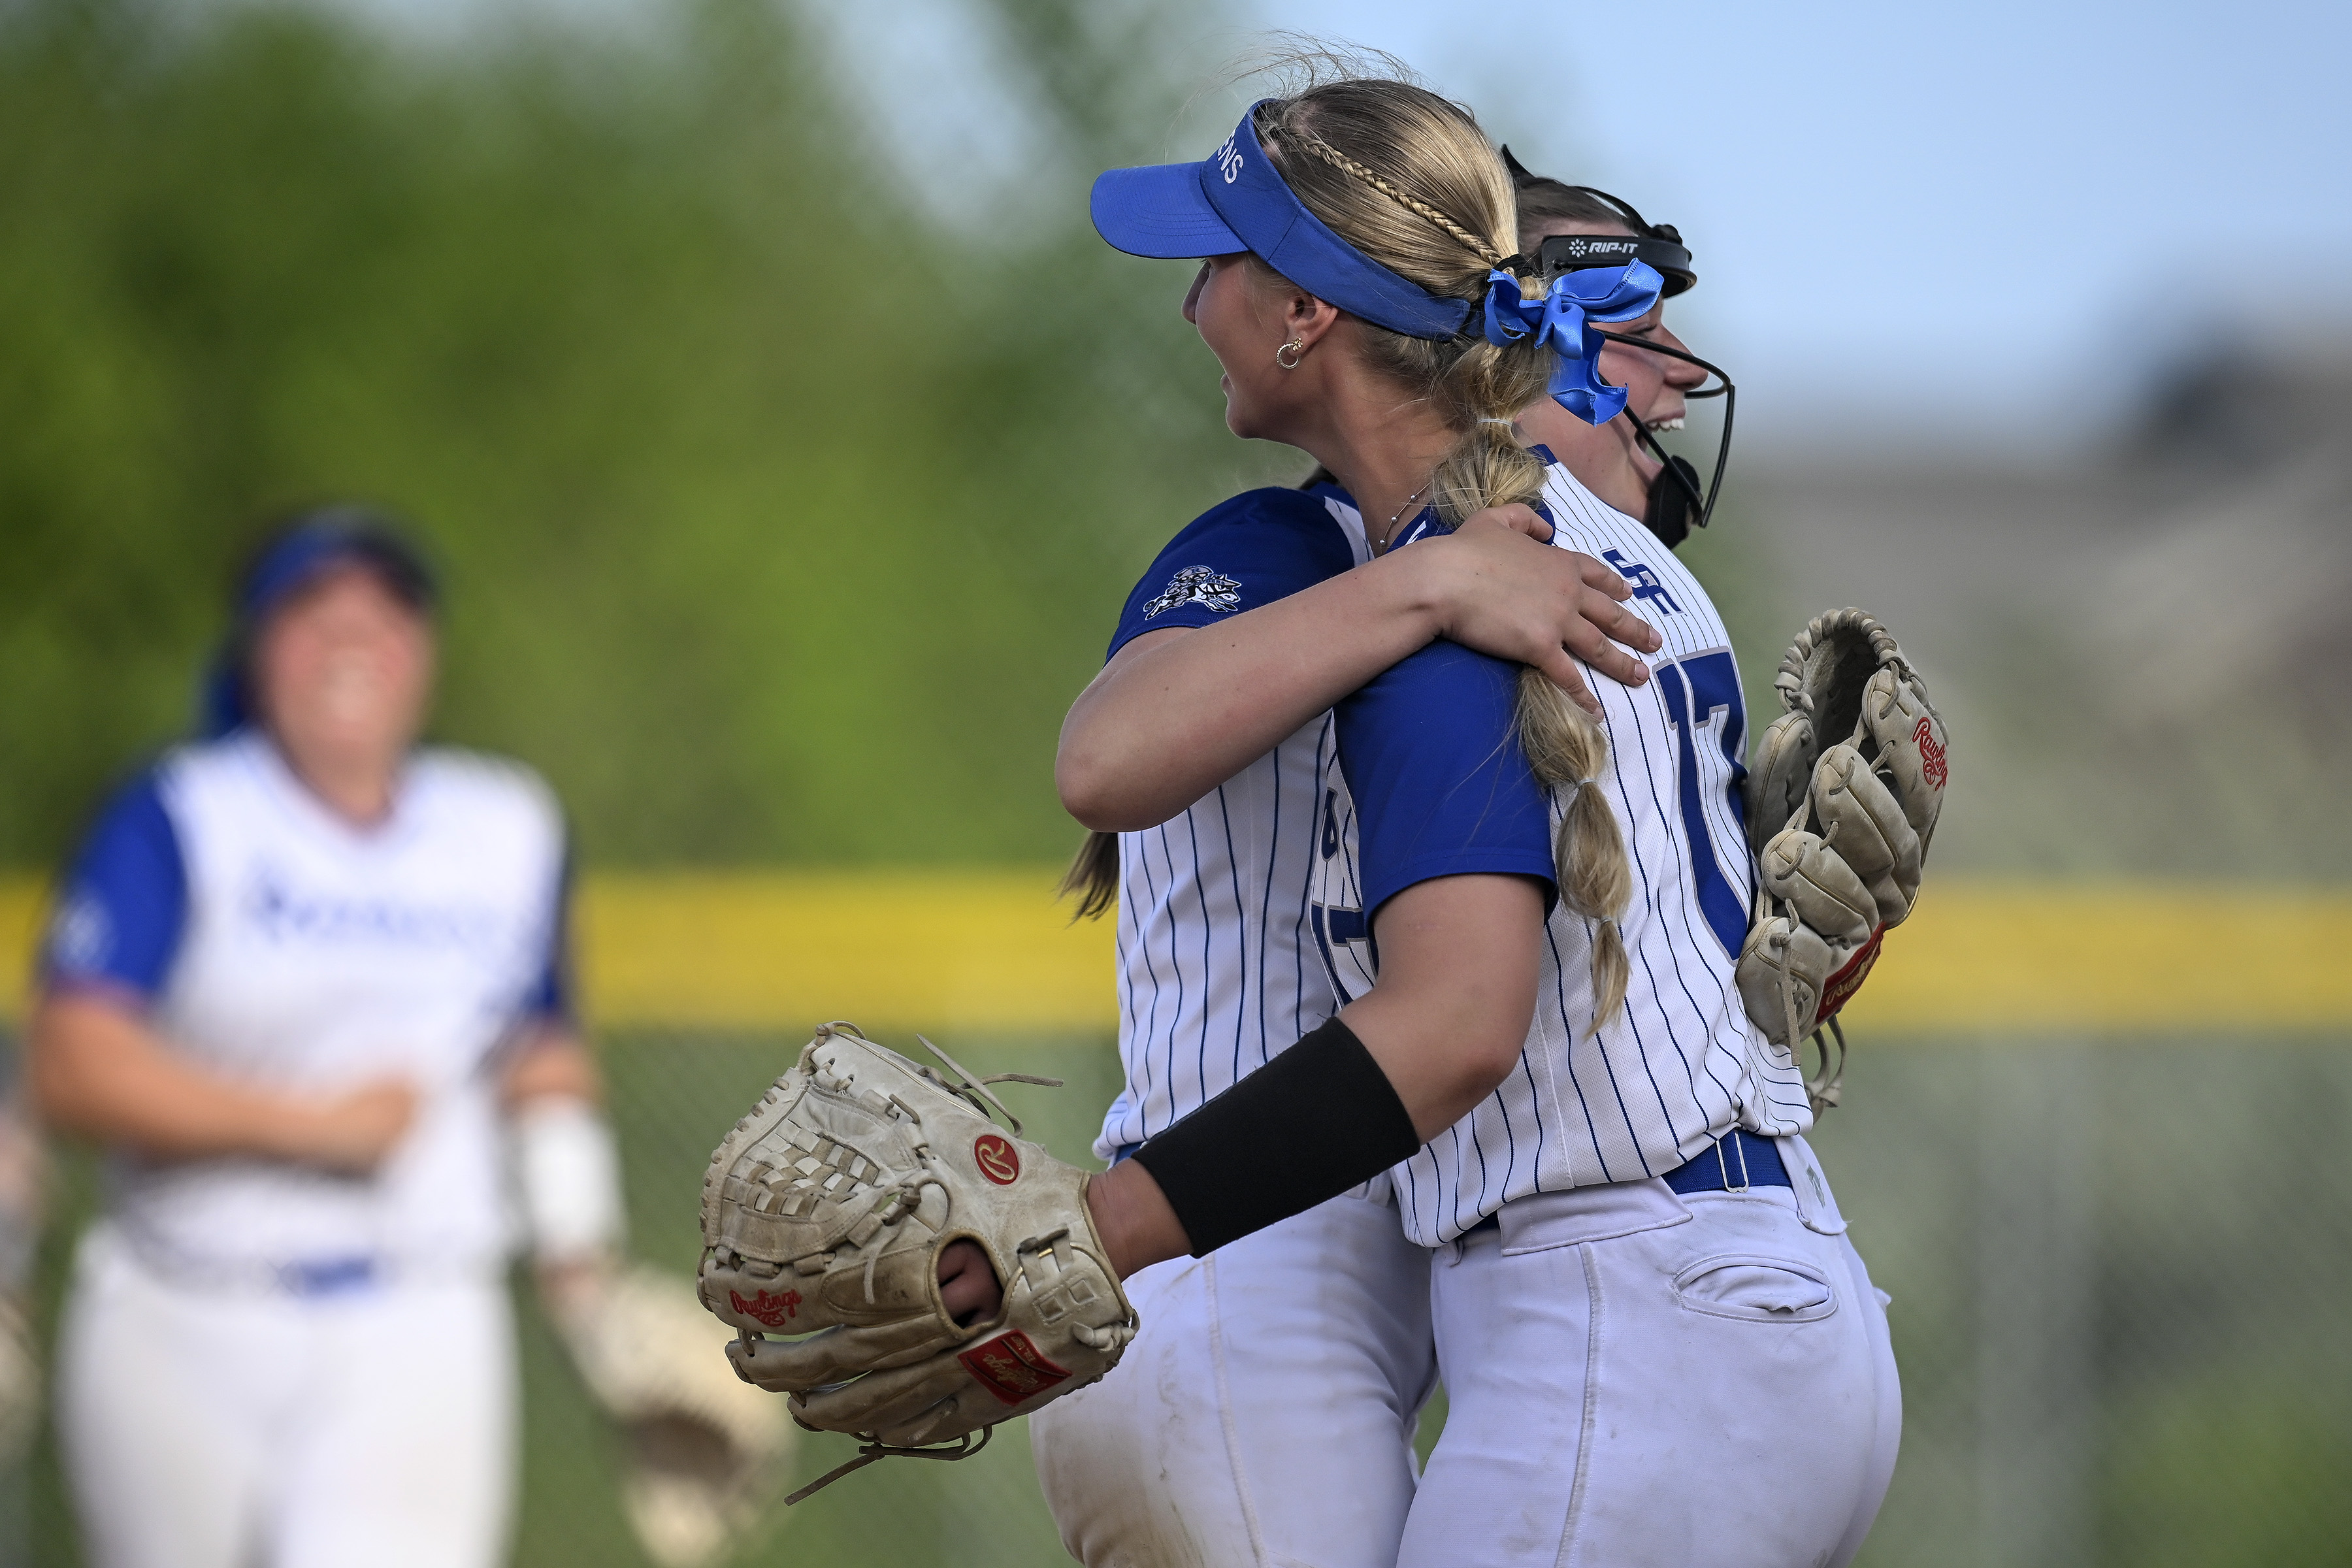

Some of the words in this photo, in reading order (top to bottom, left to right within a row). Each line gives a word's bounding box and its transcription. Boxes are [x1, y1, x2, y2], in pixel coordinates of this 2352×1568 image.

[1588, 242, 1639, 254] RIP-IT
[1652, 645, 1754, 968] 17
[977, 1140, 1016, 1181] R
[729, 1288, 802, 1327] Rawlings
